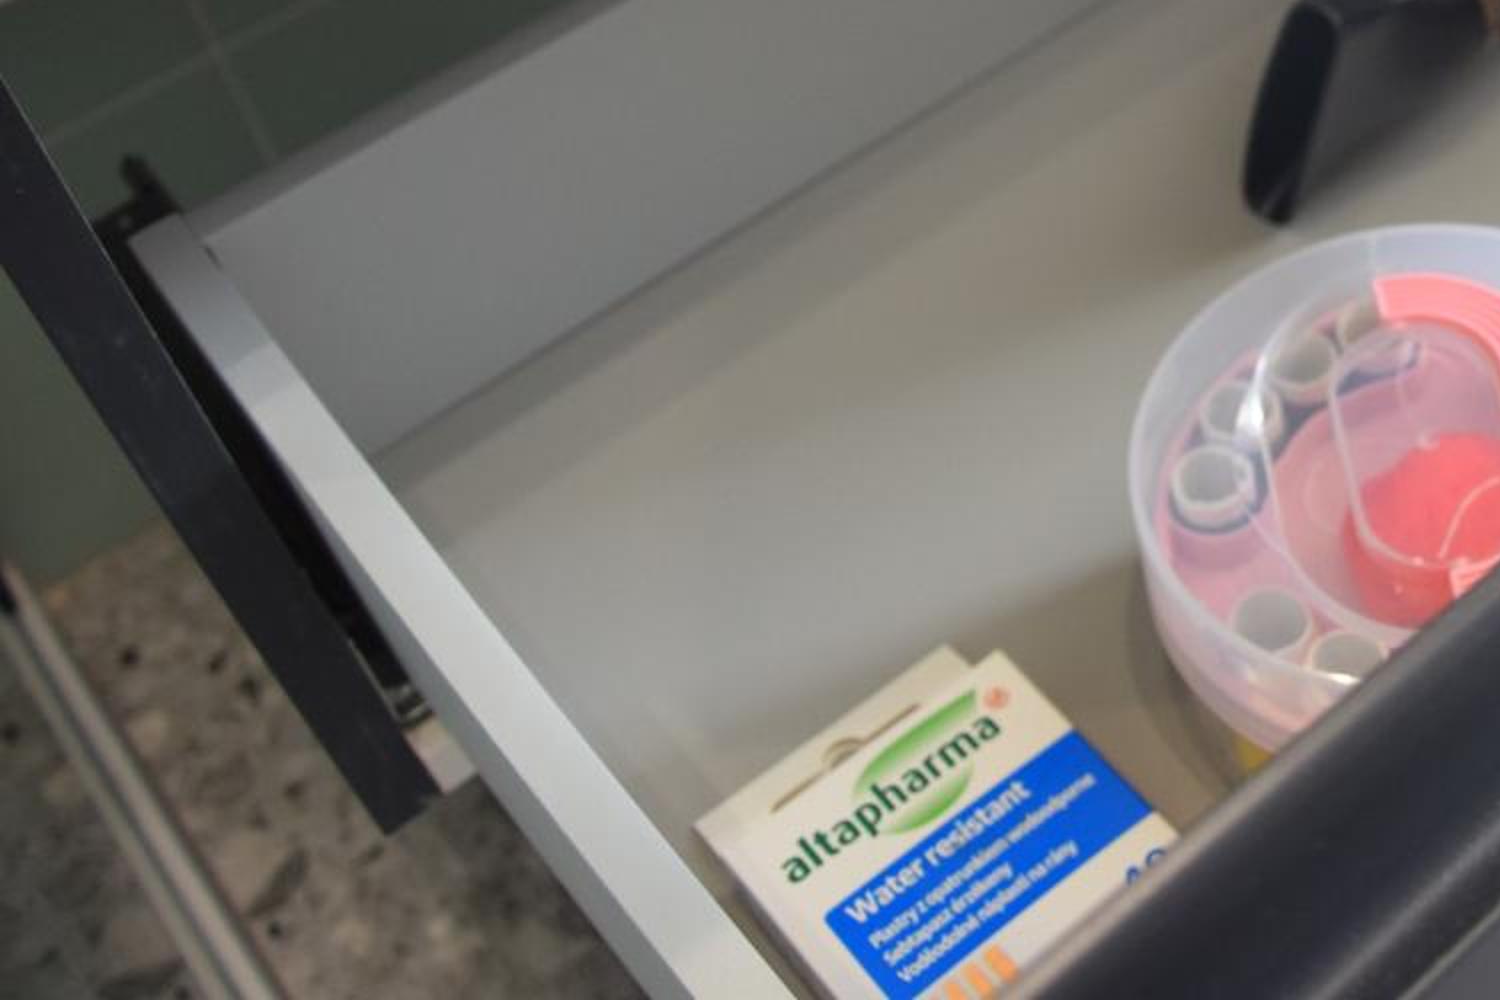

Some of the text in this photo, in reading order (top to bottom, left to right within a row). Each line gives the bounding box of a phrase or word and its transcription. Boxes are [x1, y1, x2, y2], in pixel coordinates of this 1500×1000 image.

[781, 714, 1002, 885] altapharma
[845, 780, 1031, 922] Water resistant
